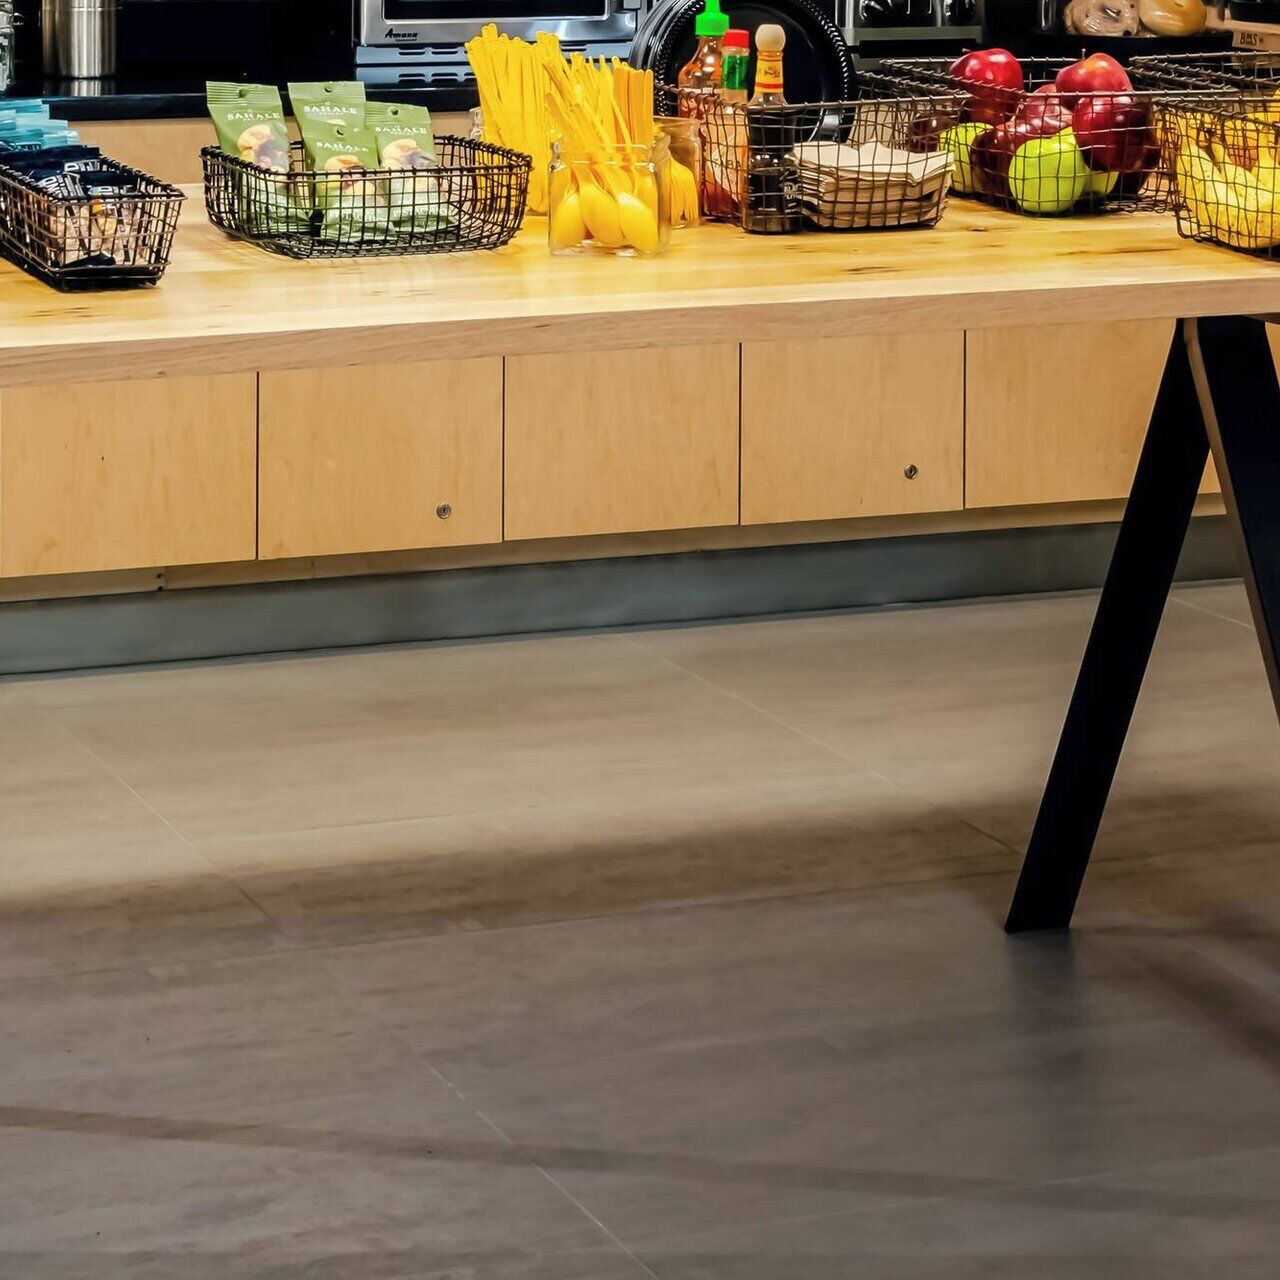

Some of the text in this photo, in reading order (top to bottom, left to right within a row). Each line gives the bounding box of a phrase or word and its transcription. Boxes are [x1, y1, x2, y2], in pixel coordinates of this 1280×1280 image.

[303, 105, 357, 115] SAHALE
[226, 112, 281, 121] SAHALE
[375, 126, 428, 134] SAHALE
